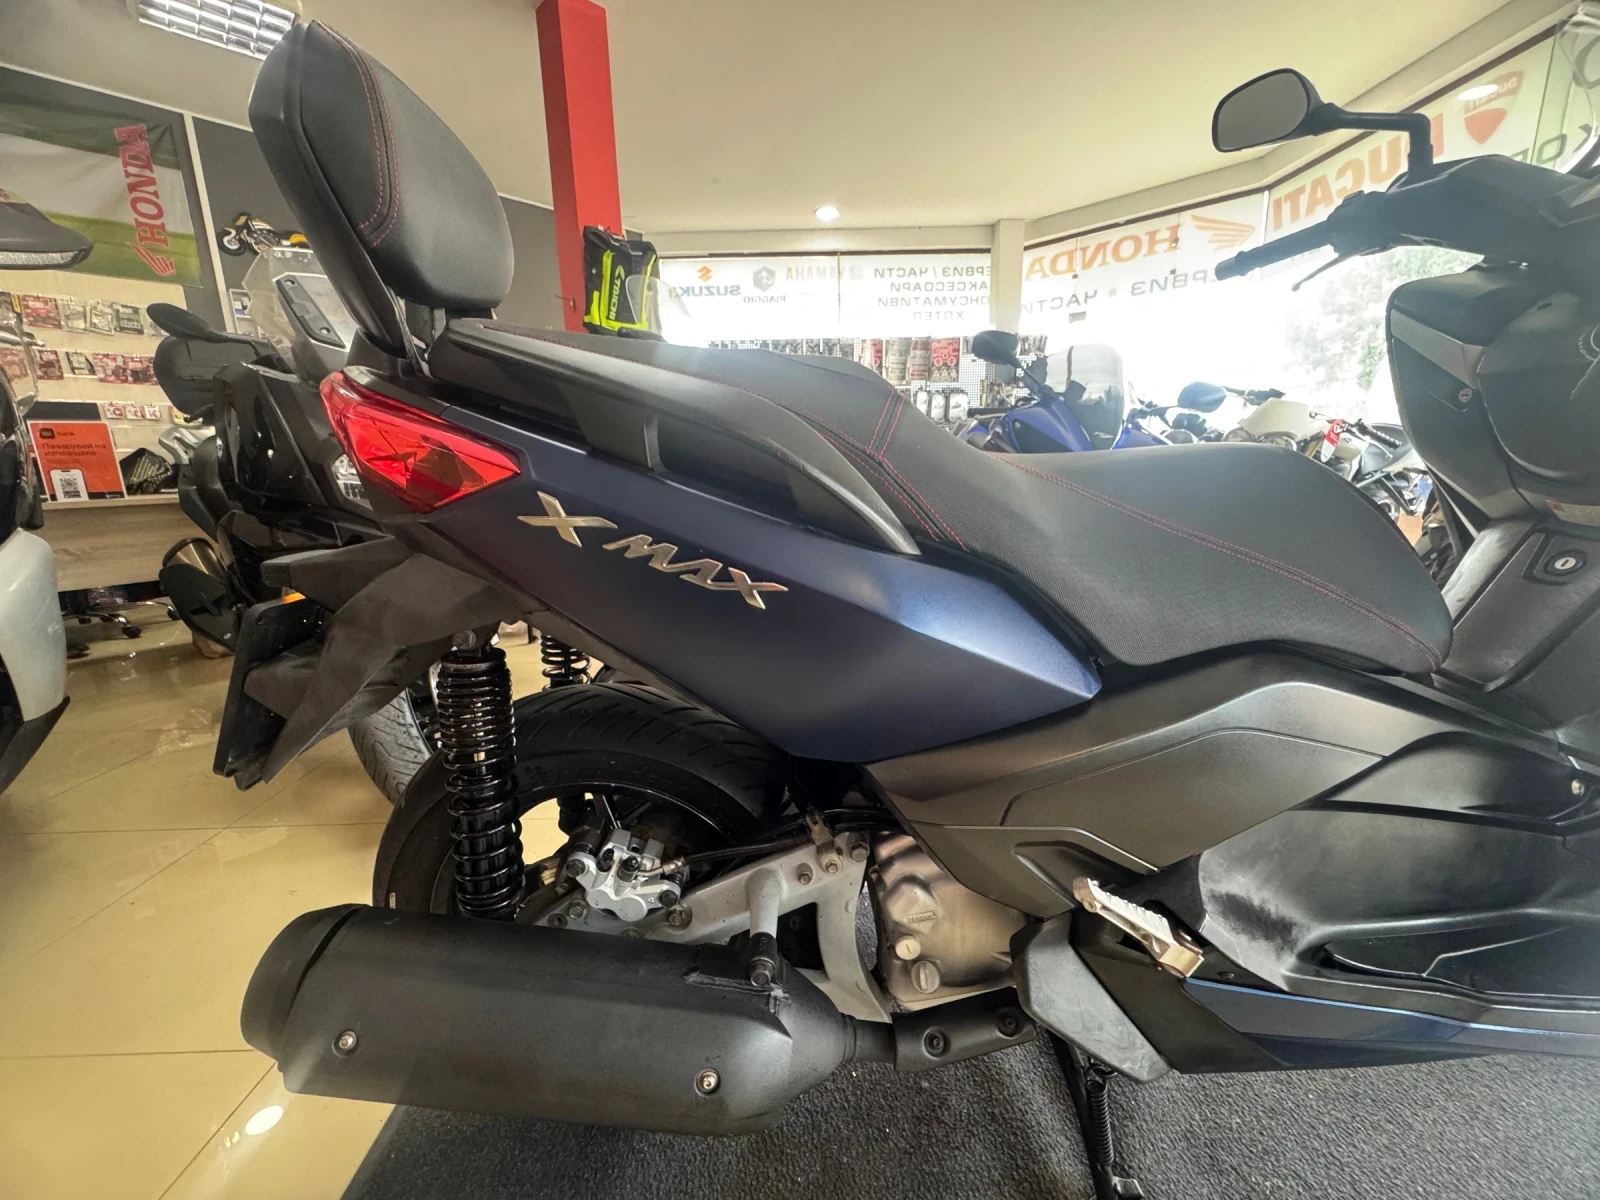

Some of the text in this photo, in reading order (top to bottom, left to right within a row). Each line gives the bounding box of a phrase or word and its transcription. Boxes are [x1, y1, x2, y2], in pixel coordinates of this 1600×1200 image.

[114, 123, 169, 247] HONDA
[42, 442, 93, 450] Пазарувай
[517, 491, 789, 610] X MAX
